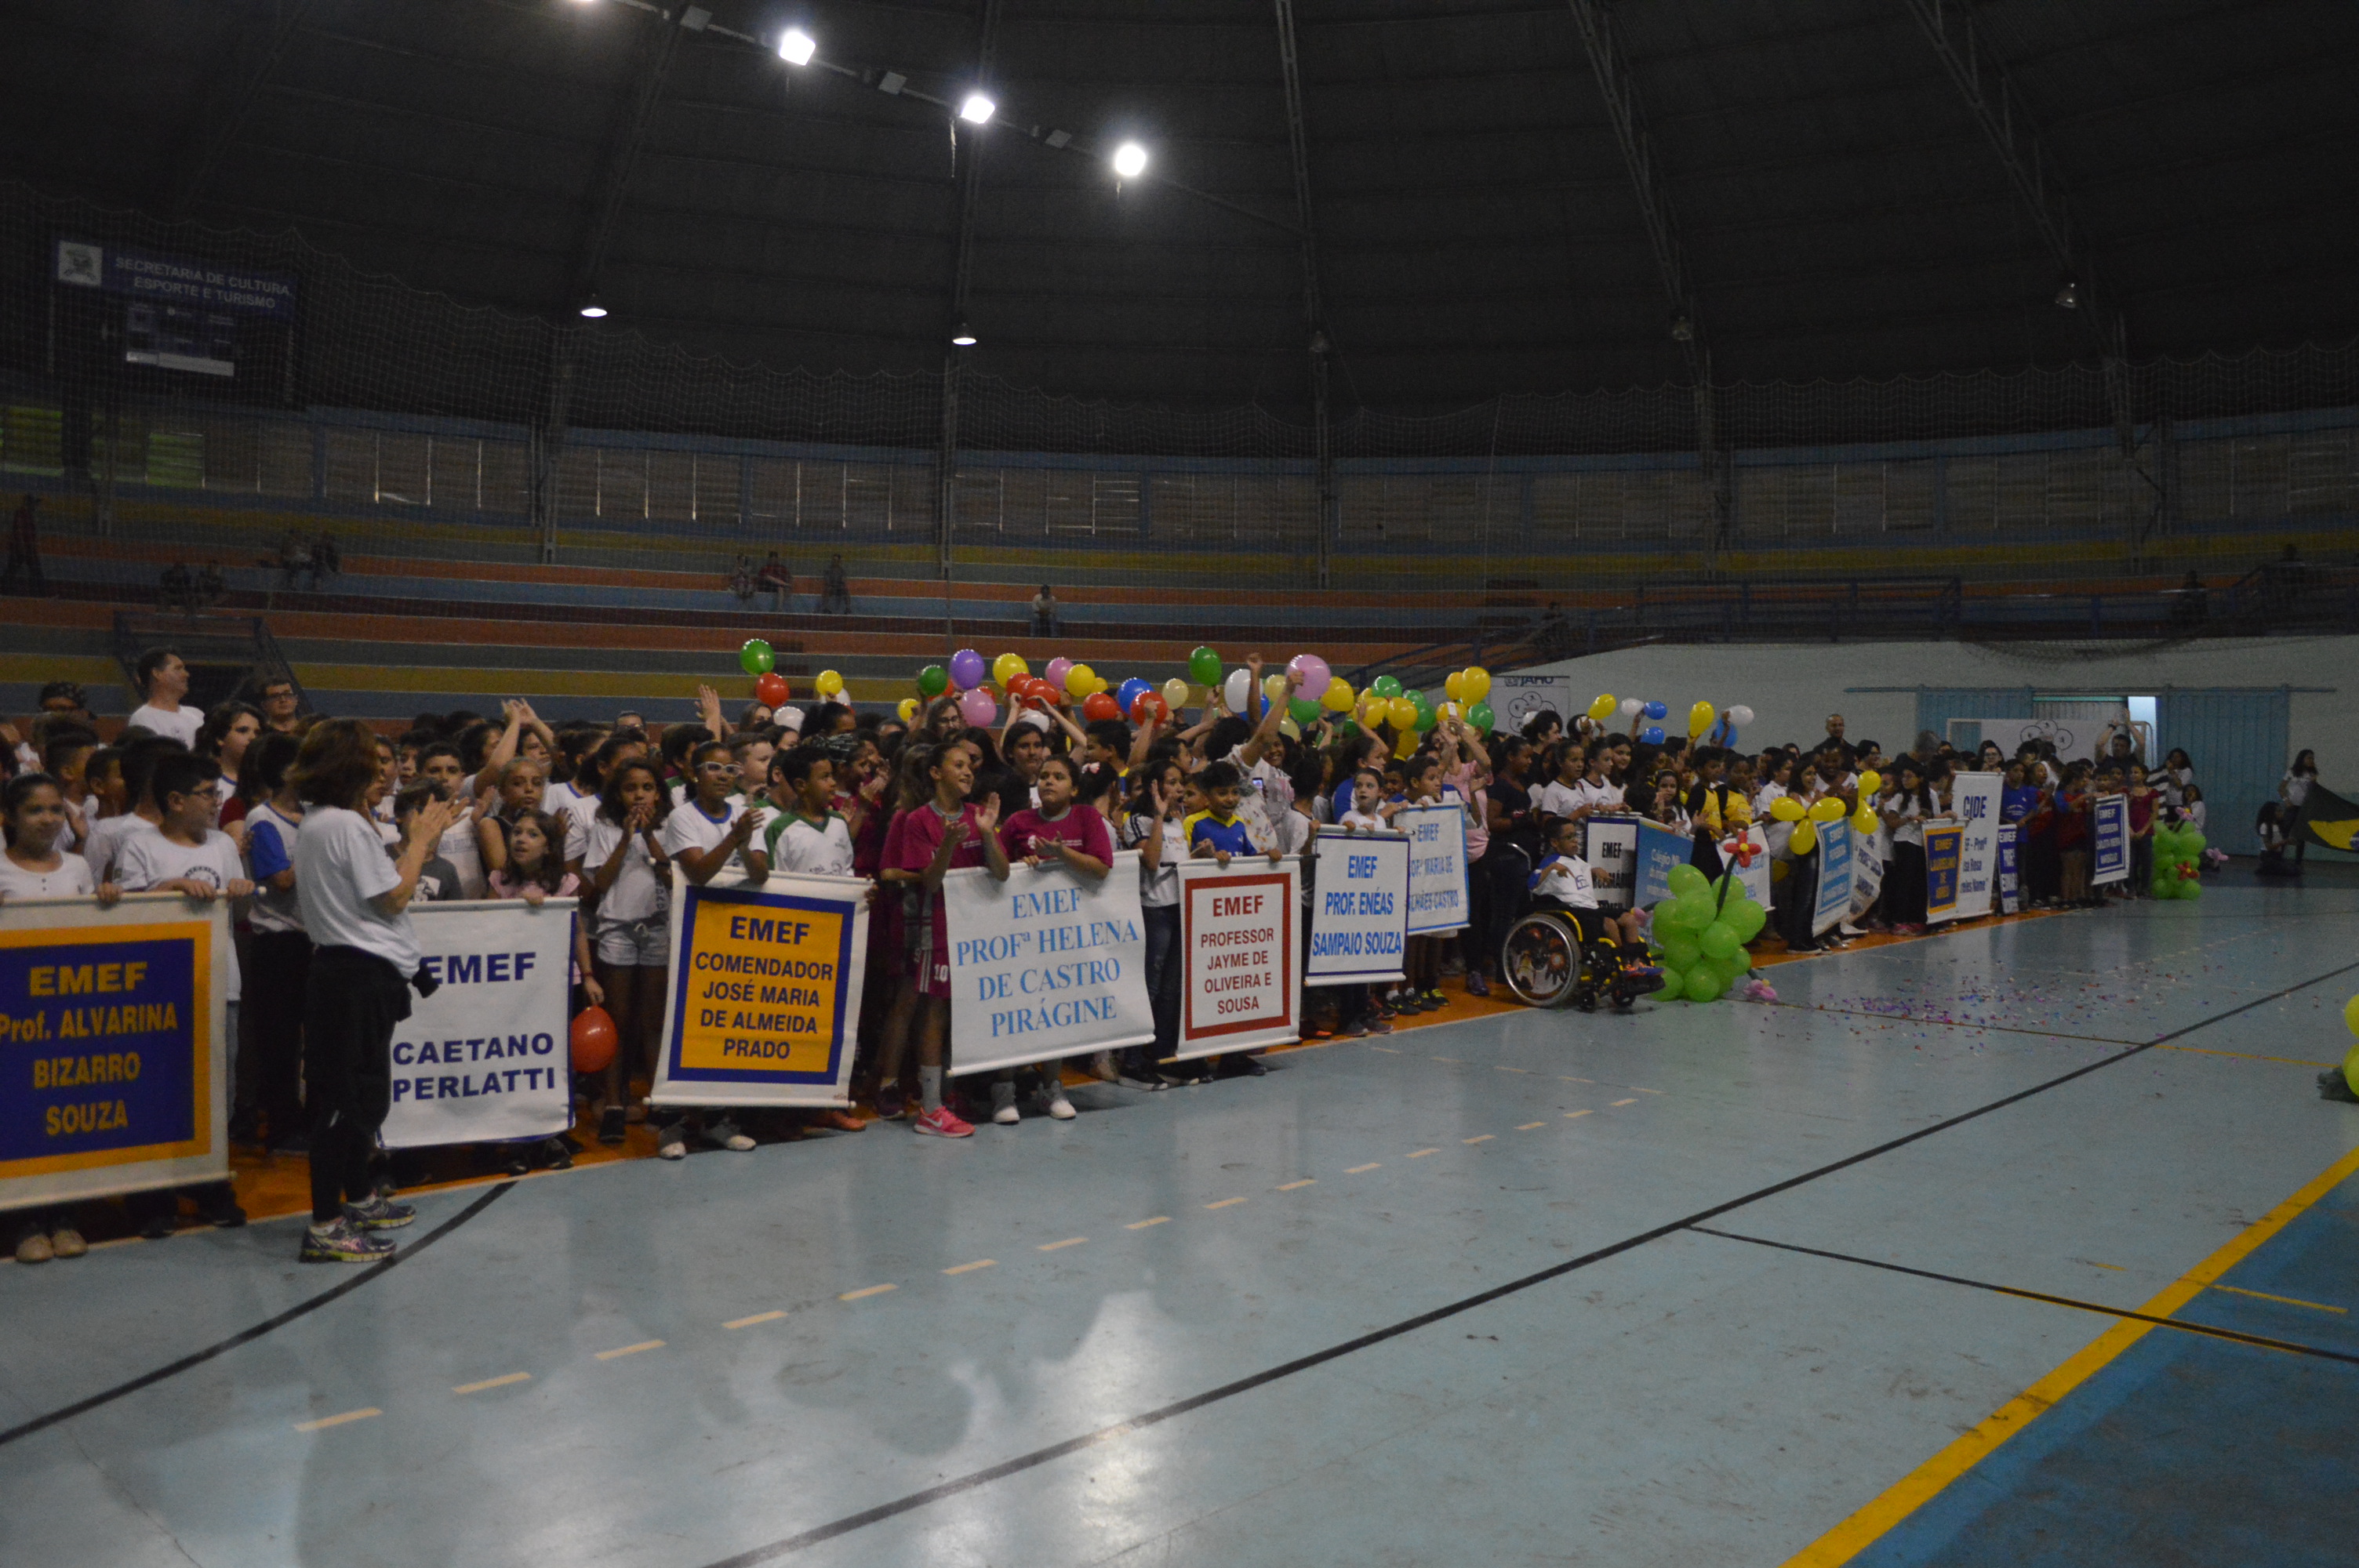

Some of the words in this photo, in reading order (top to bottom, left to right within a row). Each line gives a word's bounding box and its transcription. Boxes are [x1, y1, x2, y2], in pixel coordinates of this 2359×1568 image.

[115, 257, 203, 281] SECRETARIA
[206, 271, 225, 286] DE
[133, 276, 198, 298] ESPORTE
[202, 288, 213, 299] E
[215, 289, 276, 309] TURISMO
[1963, 796, 1987, 818] CIDE
[1417, 823, 1439, 842] EMEF
[1602, 842, 1622, 858] EMEF
[1348, 855, 1378, 879] EMEF
[1012, 887, 1083, 920] EMEF
[1212, 895, 1264, 917] EMEF
[1325, 892, 1356, 916] PROF.
[1359, 887, 1394, 916] ENÉAS
[730, 916, 810, 945] EMEF
[1038, 919, 1140, 954] HELENA
[1201, 927, 1274, 948] PROFESSOR
[1312, 932, 1362, 956] SAMPAIO
[1365, 931, 1402, 955] SOUZA
[420, 952, 536, 985] EMEF
[696, 952, 833, 981] COMENDADOR
[934, 964, 948, 983] 10
[1207, 953, 1249, 971] JAYME
[1252, 950, 1269, 965] DE
[30, 962, 147, 996] EMEF
[703, 979, 754, 1002] JOSÉ
[760, 985, 820, 1007] MARIA
[978, 973, 1013, 1001] DE
[1020, 957, 1121, 994] CASTRO
[1204, 974, 1261, 994] OLIVEIRA
[1264, 972, 1272, 986] E
[990, 995, 1118, 1037] PIRÁGINE
[1217, 996, 1259, 1014] SOUSA
[0, 1011, 52, 1042] Prof.
[60, 1002, 178, 1038] ALVARINA
[700, 1009, 727, 1028] DE
[732, 1011, 818, 1034] ALMEIDA
[393, 1033, 554, 1065] CAETANO
[723, 1038, 790, 1059] PRADO
[34, 1052, 141, 1089] BIZARRO
[393, 1067, 555, 1102] PERLATTI
[46, 1100, 129, 1136] SOUZA
